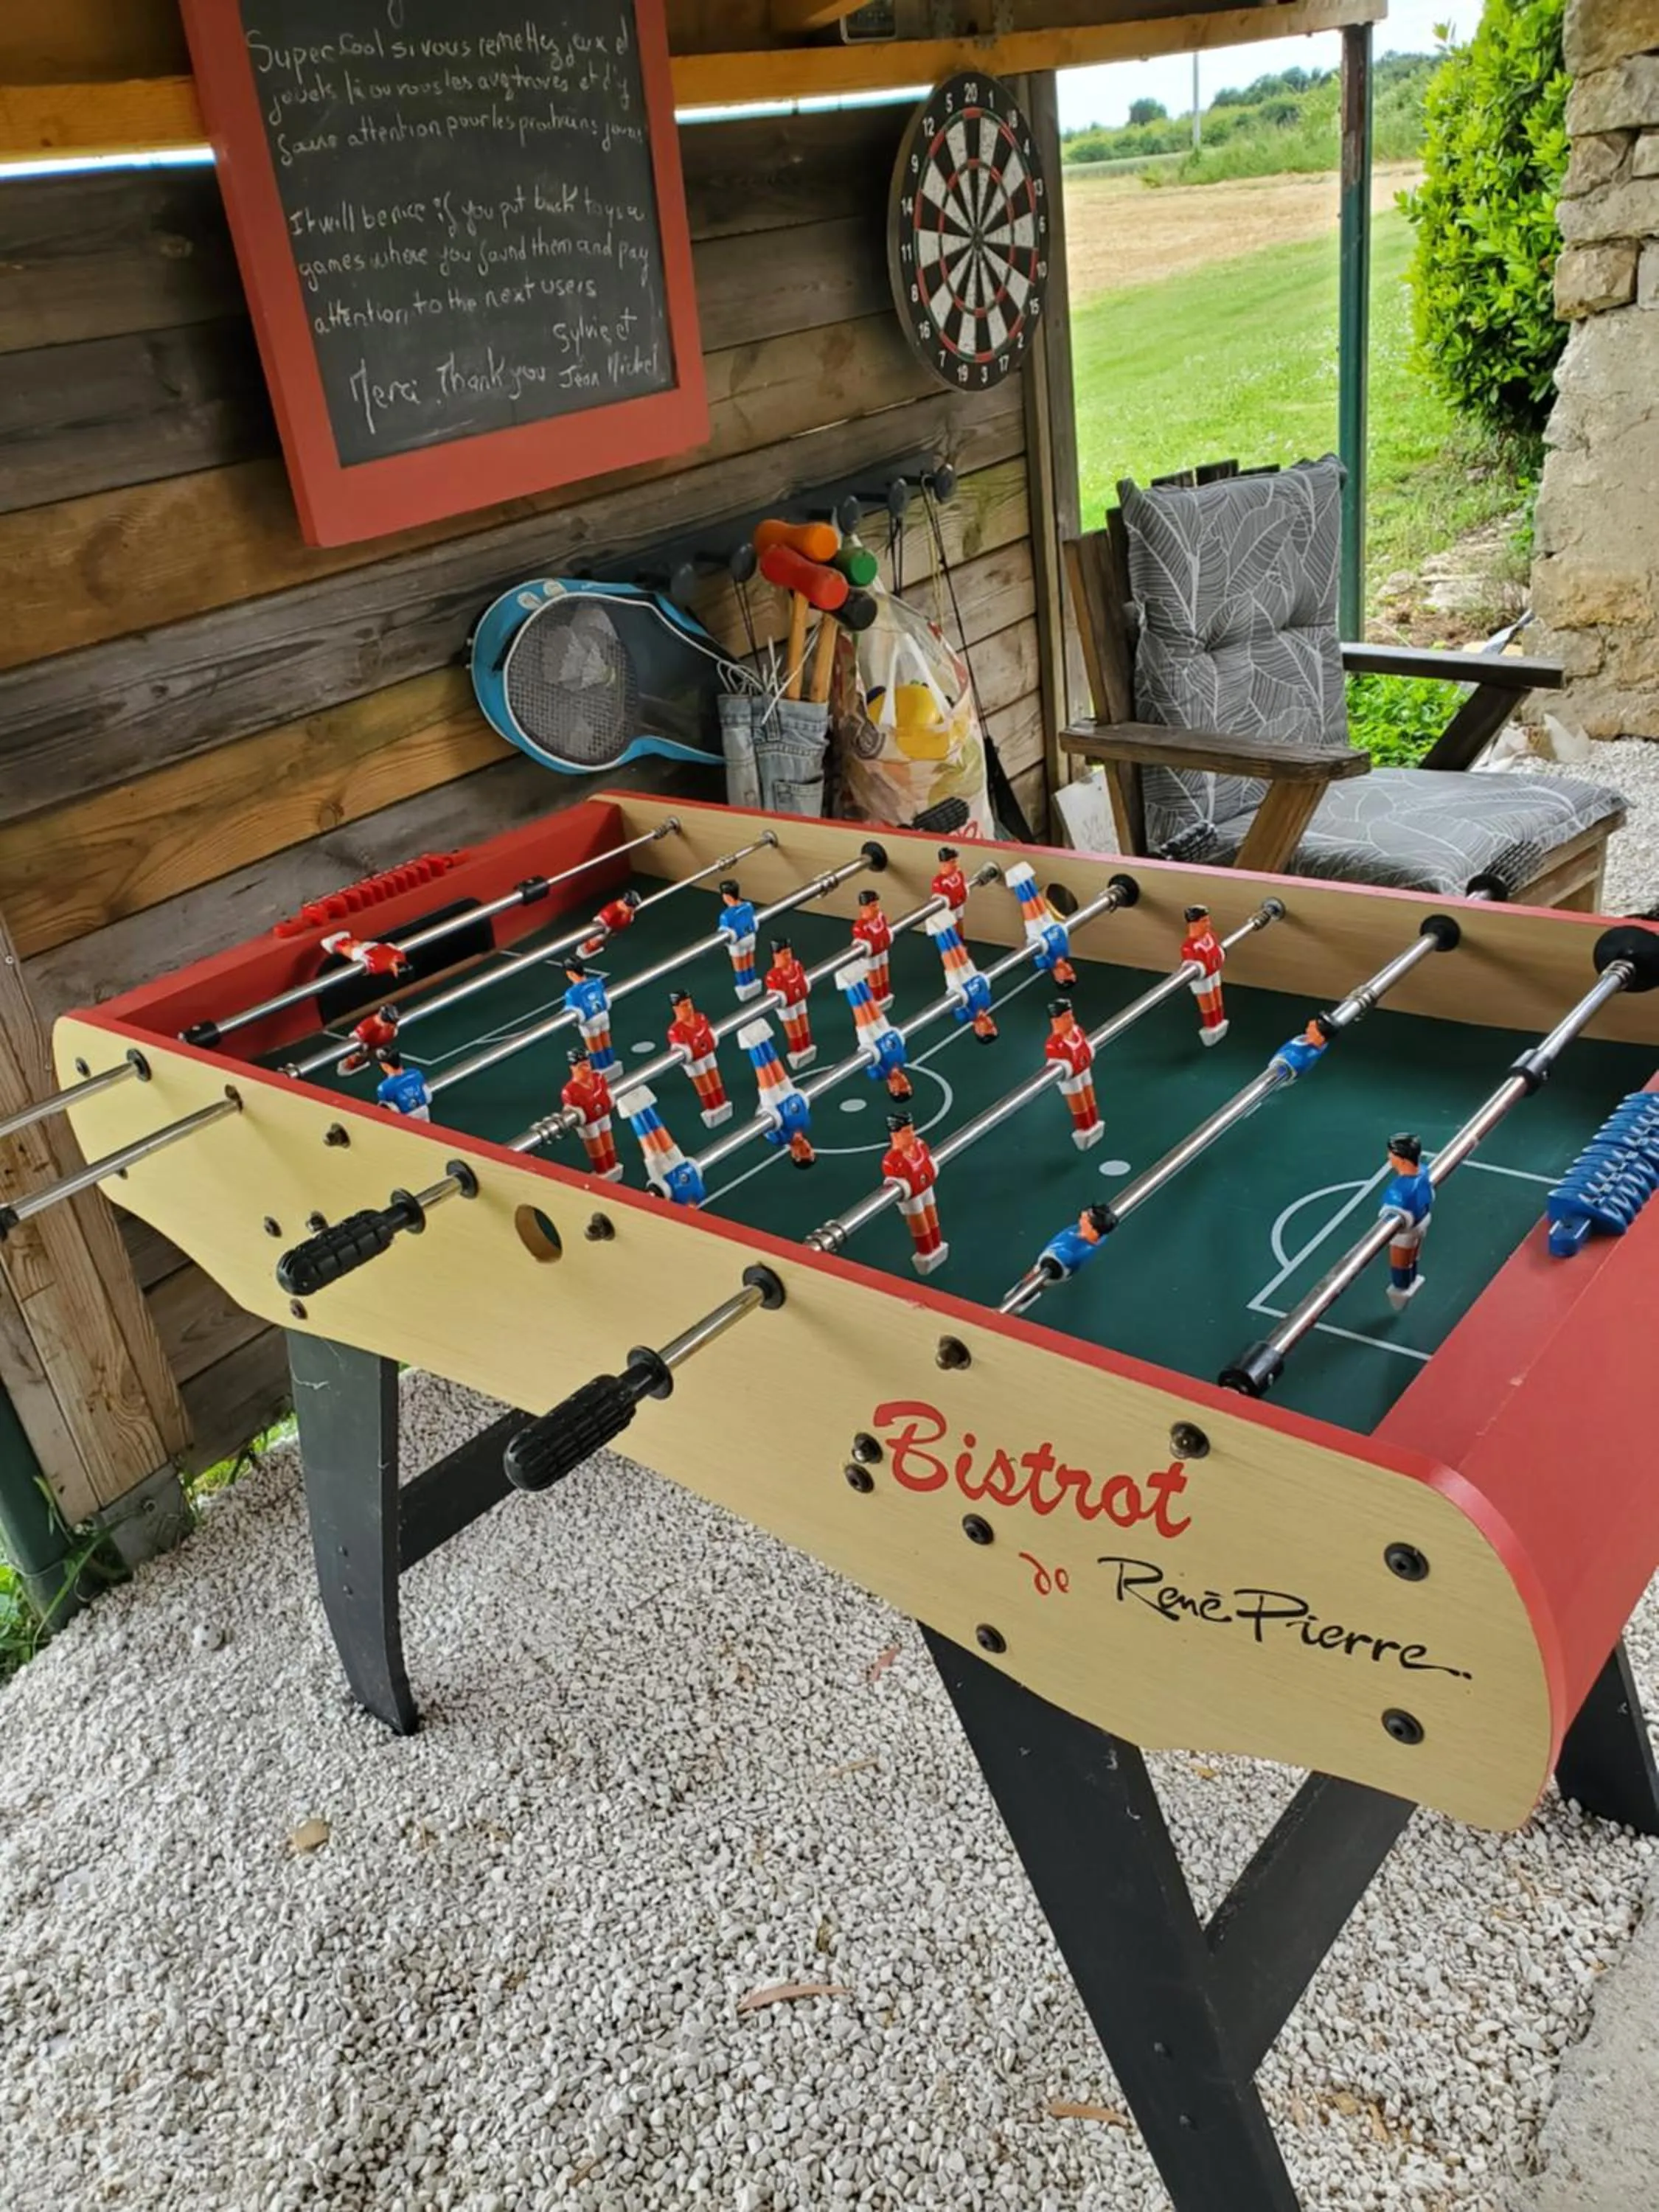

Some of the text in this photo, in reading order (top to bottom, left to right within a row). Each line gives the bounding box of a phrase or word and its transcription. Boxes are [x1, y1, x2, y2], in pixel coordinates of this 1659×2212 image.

[246, 30, 335, 84] Super
[422, 38, 470, 57] vous
[397, 80, 442, 94] vous
[445, 69, 472, 91] les
[580, 60, 597, 91] et
[946, 93, 953, 112] 5
[964, 83, 978, 103] 20
[989, 90, 994, 108] 1
[347, 113, 441, 147] attention
[447, 113, 487, 141] pour
[492, 104, 515, 130] les
[922, 117, 935, 136] 12
[1023, 139, 1030, 156] 4
[911, 154, 919, 173] 9
[318, 201, 355, 234] will
[361, 206, 387, 229] be
[462, 201, 493, 236] you
[501, 185, 525, 229] put
[901, 196, 913, 215] 14
[1039, 215, 1046, 233] 6
[299, 254, 365, 292] games
[439, 246, 470, 276] you
[478, 235, 526, 276] found
[532, 226, 572, 256] them
[577, 232, 611, 255] and
[619, 241, 648, 287] pay
[901, 243, 912, 262] 11
[911, 283, 919, 302] 8
[315, 299, 408, 333] attention
[413, 291, 442, 313] to
[448, 288, 476, 312] the
[486, 273, 535, 307] next
[1029, 298, 1040, 316] 15
[616, 307, 637, 340] et
[919, 320, 931, 338] 16
[1017, 332, 1024, 349] 2
[939, 350, 947, 367] 7
[998, 355, 1009, 372] 17
[437, 346, 505, 396] Thank
[509, 366, 546, 400] you
[873, 1400, 1192, 1539] Bistrot
[1018, 1552, 1069, 1596] de
